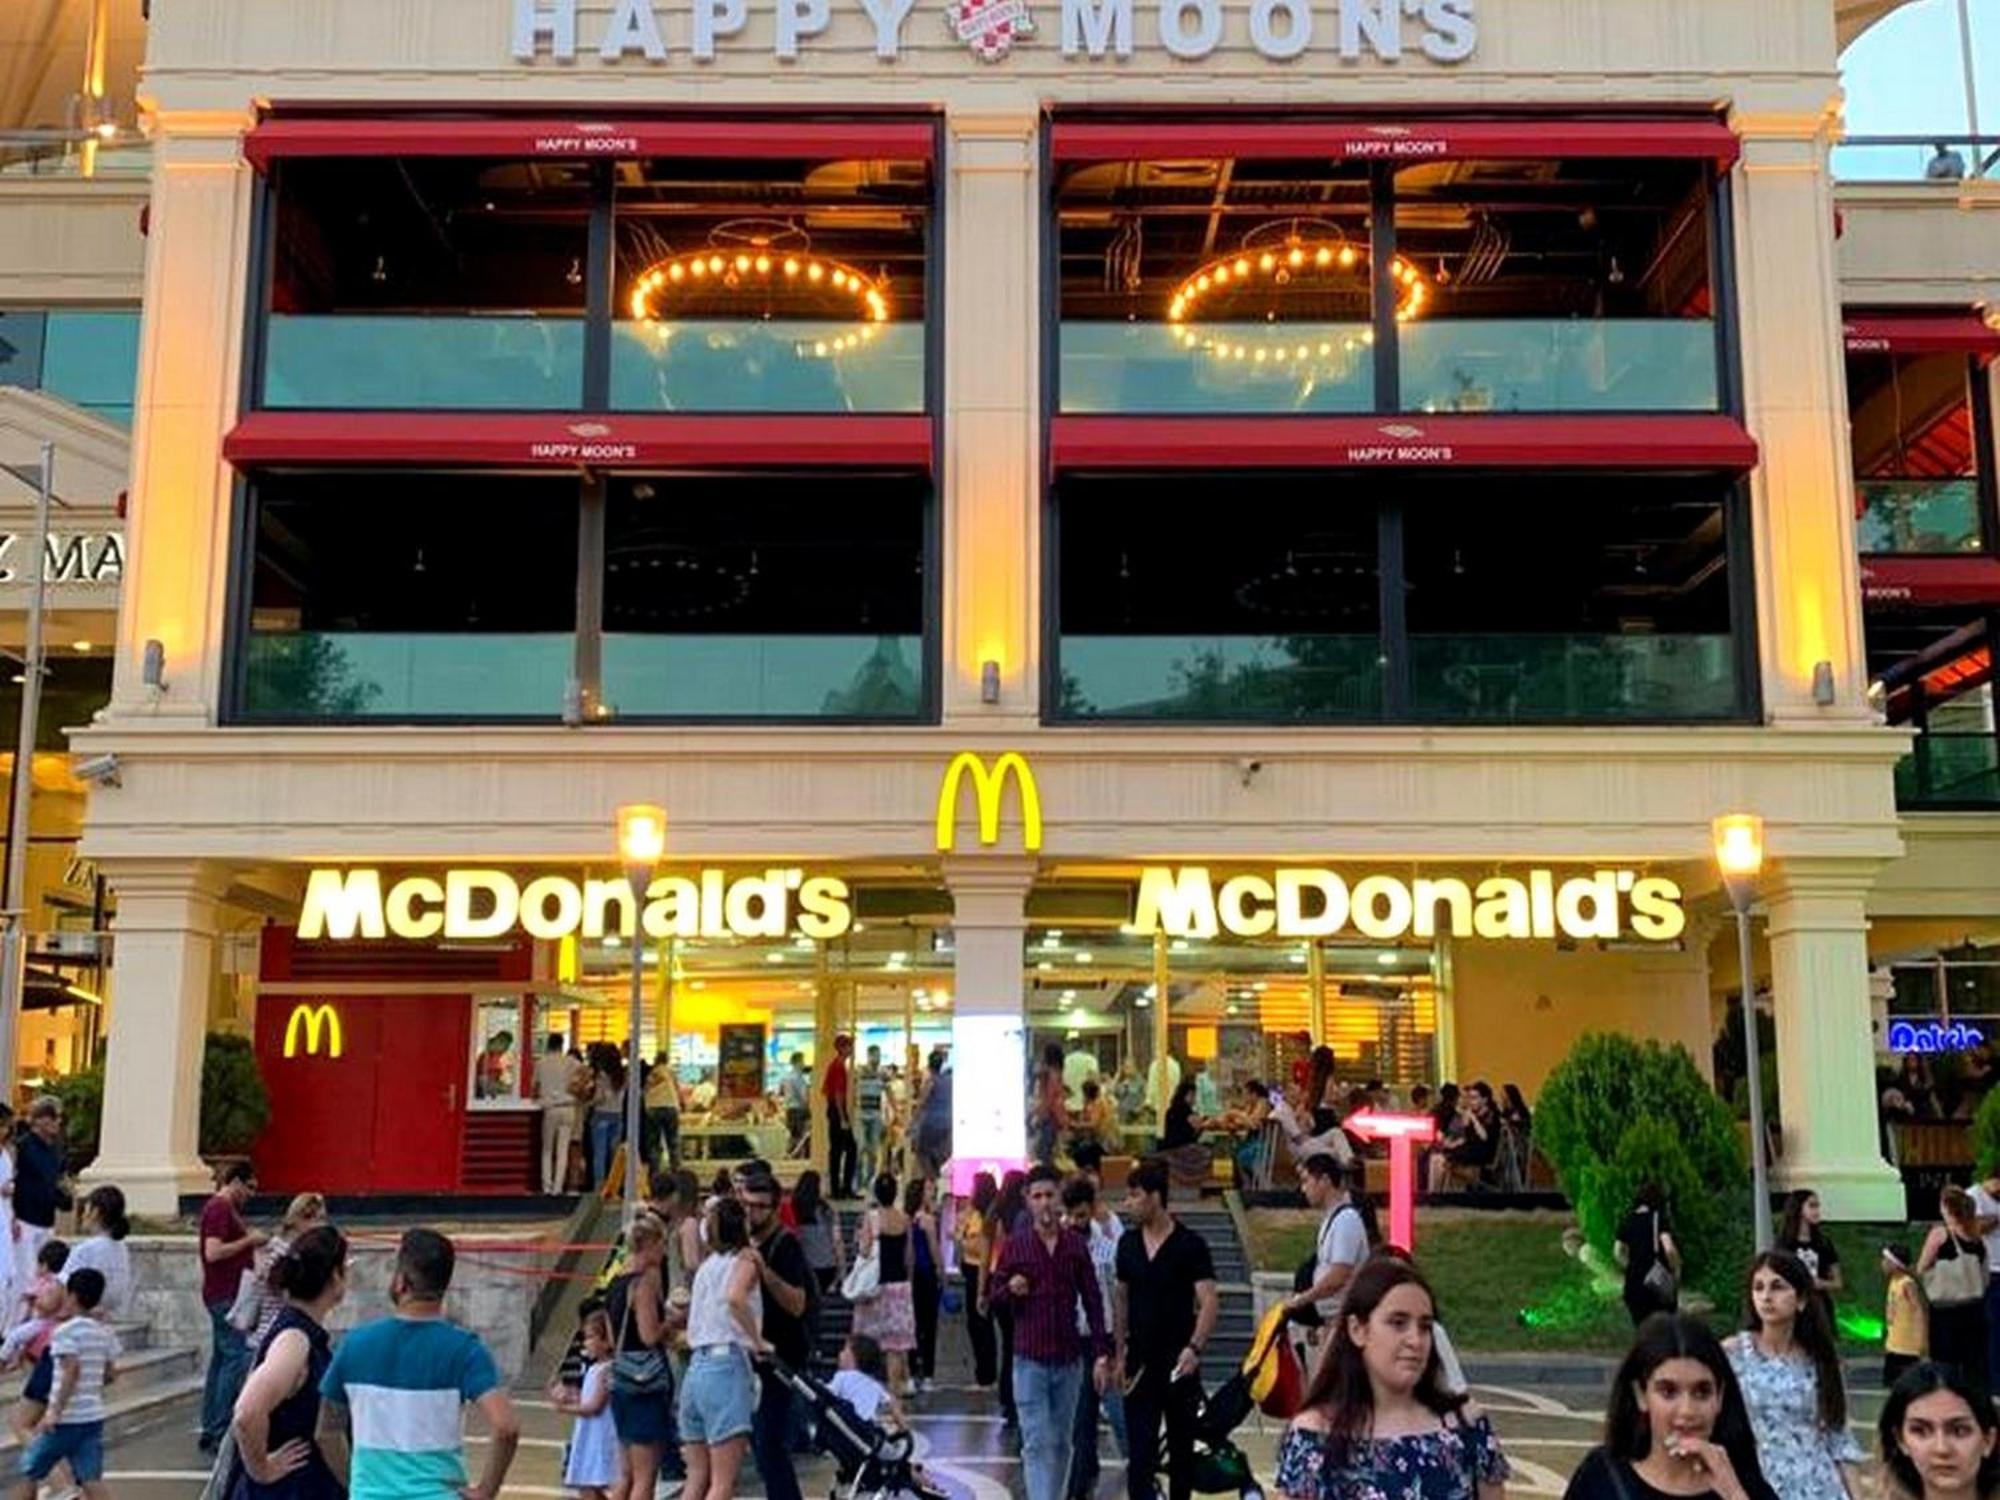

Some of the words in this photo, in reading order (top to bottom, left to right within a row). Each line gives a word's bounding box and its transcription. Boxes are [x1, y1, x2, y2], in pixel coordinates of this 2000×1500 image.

[510, 0, 912, 65] HAPPY
[1059, 0, 1478, 63] MOON'S
[535, 138, 580, 151] HAPPY
[1345, 141, 1391, 154] HAPPY
[531, 444, 578, 457] HAPPY
[1348, 446, 1395, 461] HAPPY
[296, 868, 850, 940] McDonald's
[1132, 866, 1686, 940] McDonald's
